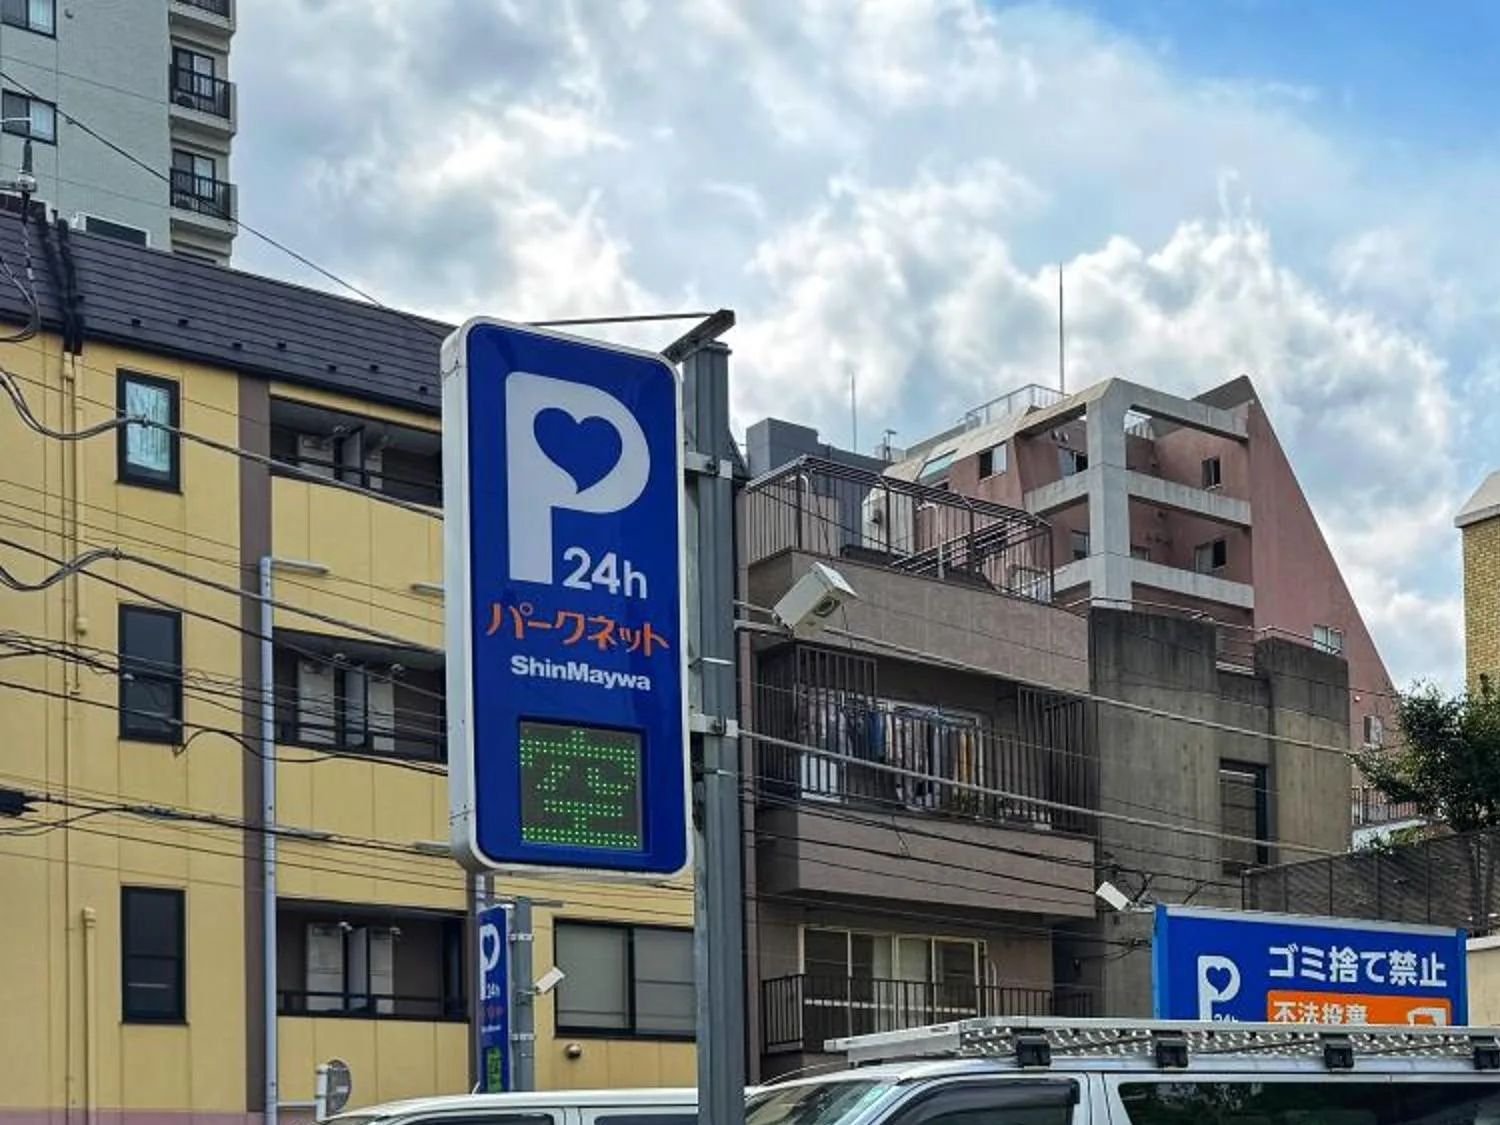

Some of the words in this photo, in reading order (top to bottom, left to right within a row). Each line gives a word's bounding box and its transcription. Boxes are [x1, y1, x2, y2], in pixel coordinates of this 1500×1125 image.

[506, 371, 650, 584] P
[563, 547, 647, 599] 24h
[486, 603, 669, 656] パークネット
[511, 655, 651, 691] ShinMaywa
[520, 729, 638, 848] 空
[1198, 955, 1241, 1021] P
[1268, 943, 1447, 987] ゴミ捨て禁止
